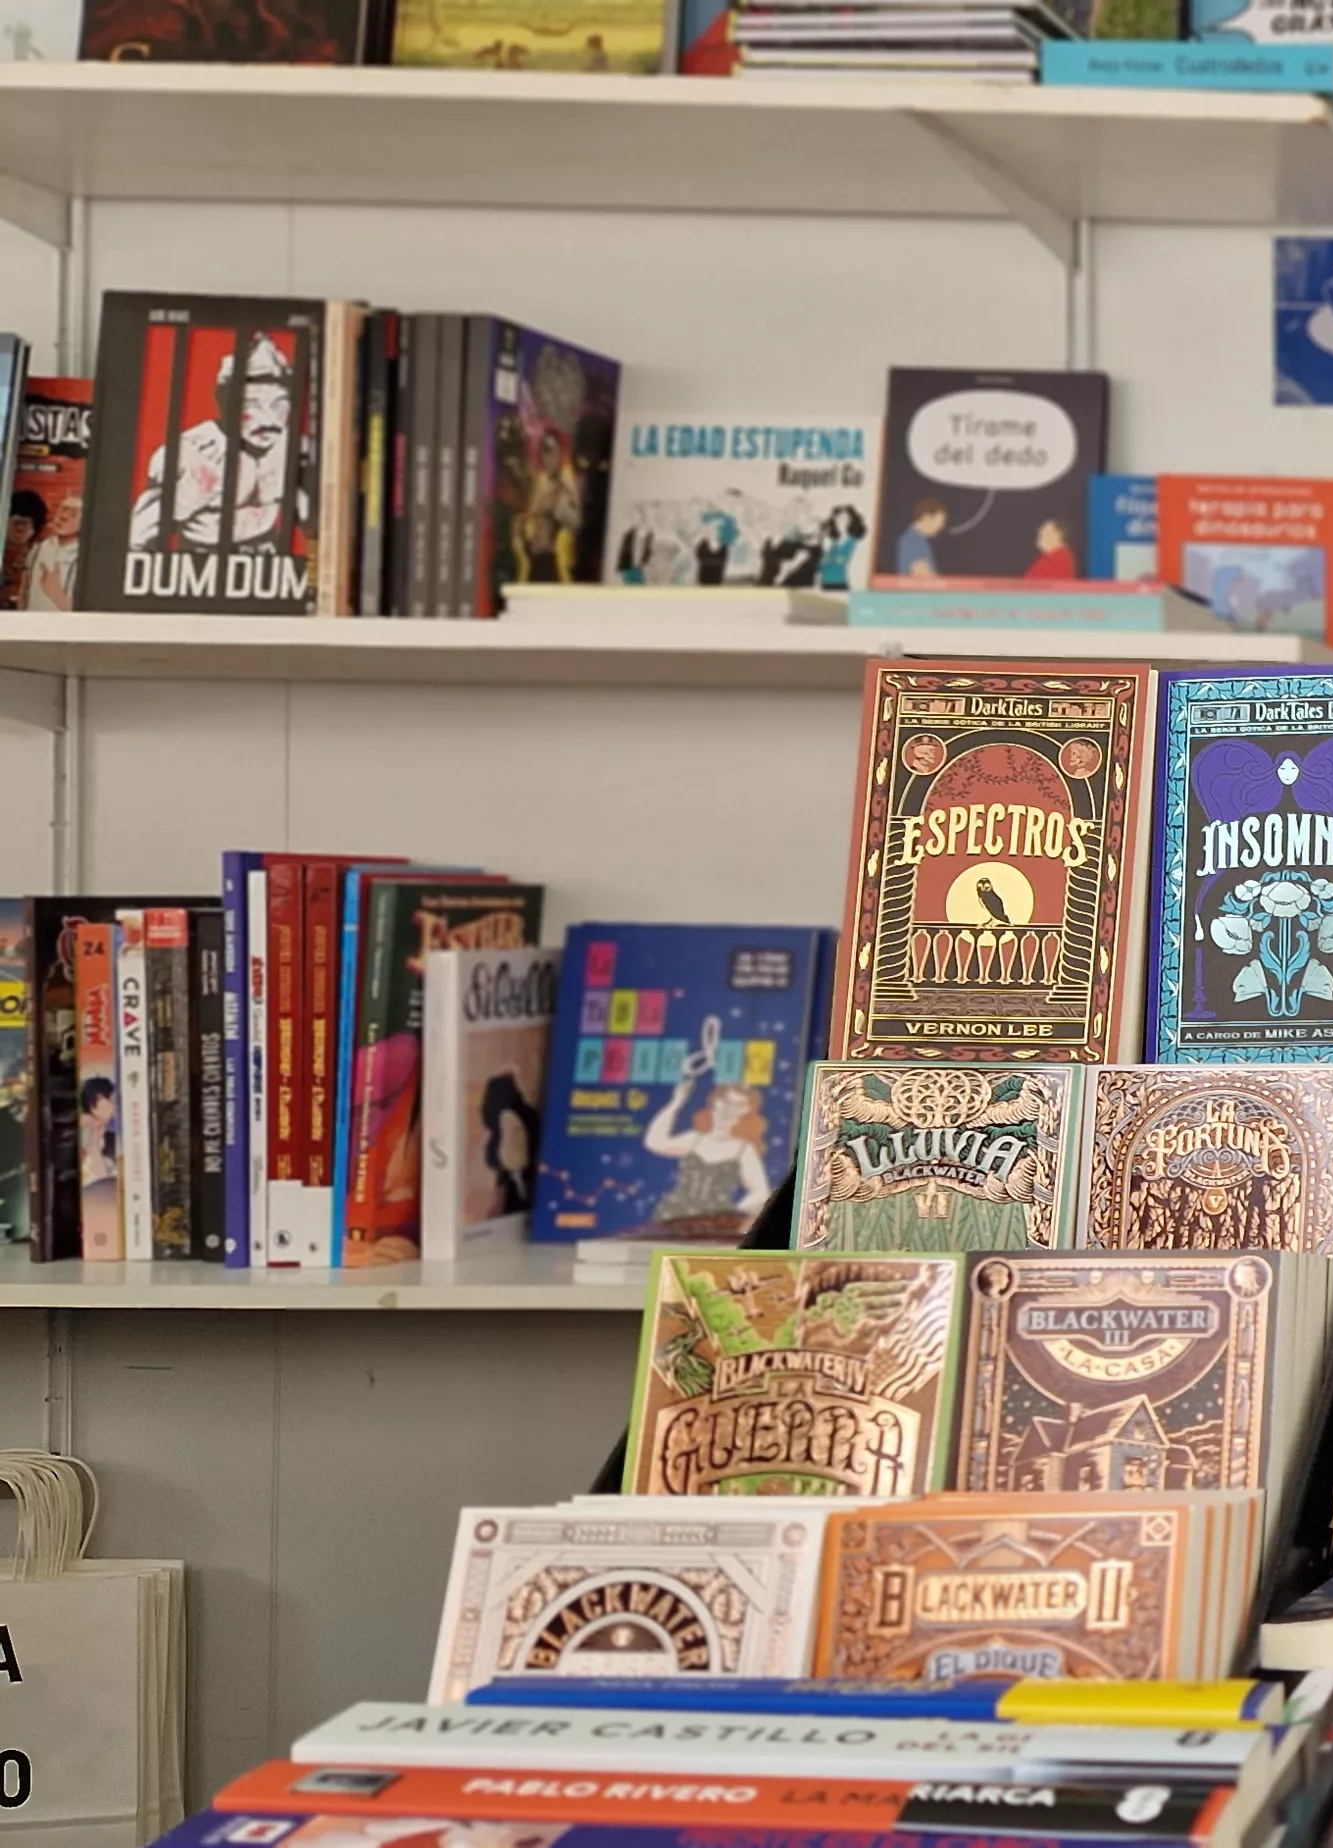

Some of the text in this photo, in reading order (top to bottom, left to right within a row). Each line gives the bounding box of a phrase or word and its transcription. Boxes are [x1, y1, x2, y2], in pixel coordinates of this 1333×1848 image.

[949, 412, 1038, 438] Tírame
[631, 424, 865, 460] LA EDAD ESTUPENDA
[934, 442, 1049, 465] del dedo
[124, 551, 309, 599] DUM DUM
[896, 803, 1094, 867] ESPECTROS
[121, 975, 142, 1057] CRAVE
[905, 1021, 1053, 1039] VERNON LEE
[1183, 1031, 1193, 1041] A
[1195, 1030, 1240, 1042] CARGO
[1243, 1029, 1262, 1040] DE
[1264, 1026, 1308, 1041] MIKE
[1206, 1101, 1236, 1124] LA
[845, 1127, 1028, 1183] LLUVIA
[882, 1162, 987, 1188] BLACKWATER
[1029, 1309, 1208, 1331] BLACKWATER
[1104, 1330, 1131, 1346] III
[722, 1353, 847, 1389] BLACKWATER
[1063, 1350, 1171, 1379] LA CASA
[525, 1581, 712, 1672] BLACKWATER
[931, 1653, 963, 1677] EL
[356, 1713, 878, 1749] JAVIER CASTILLO
[462, 1776, 1058, 1810] PABLO RIVERO LA MARIARCA
